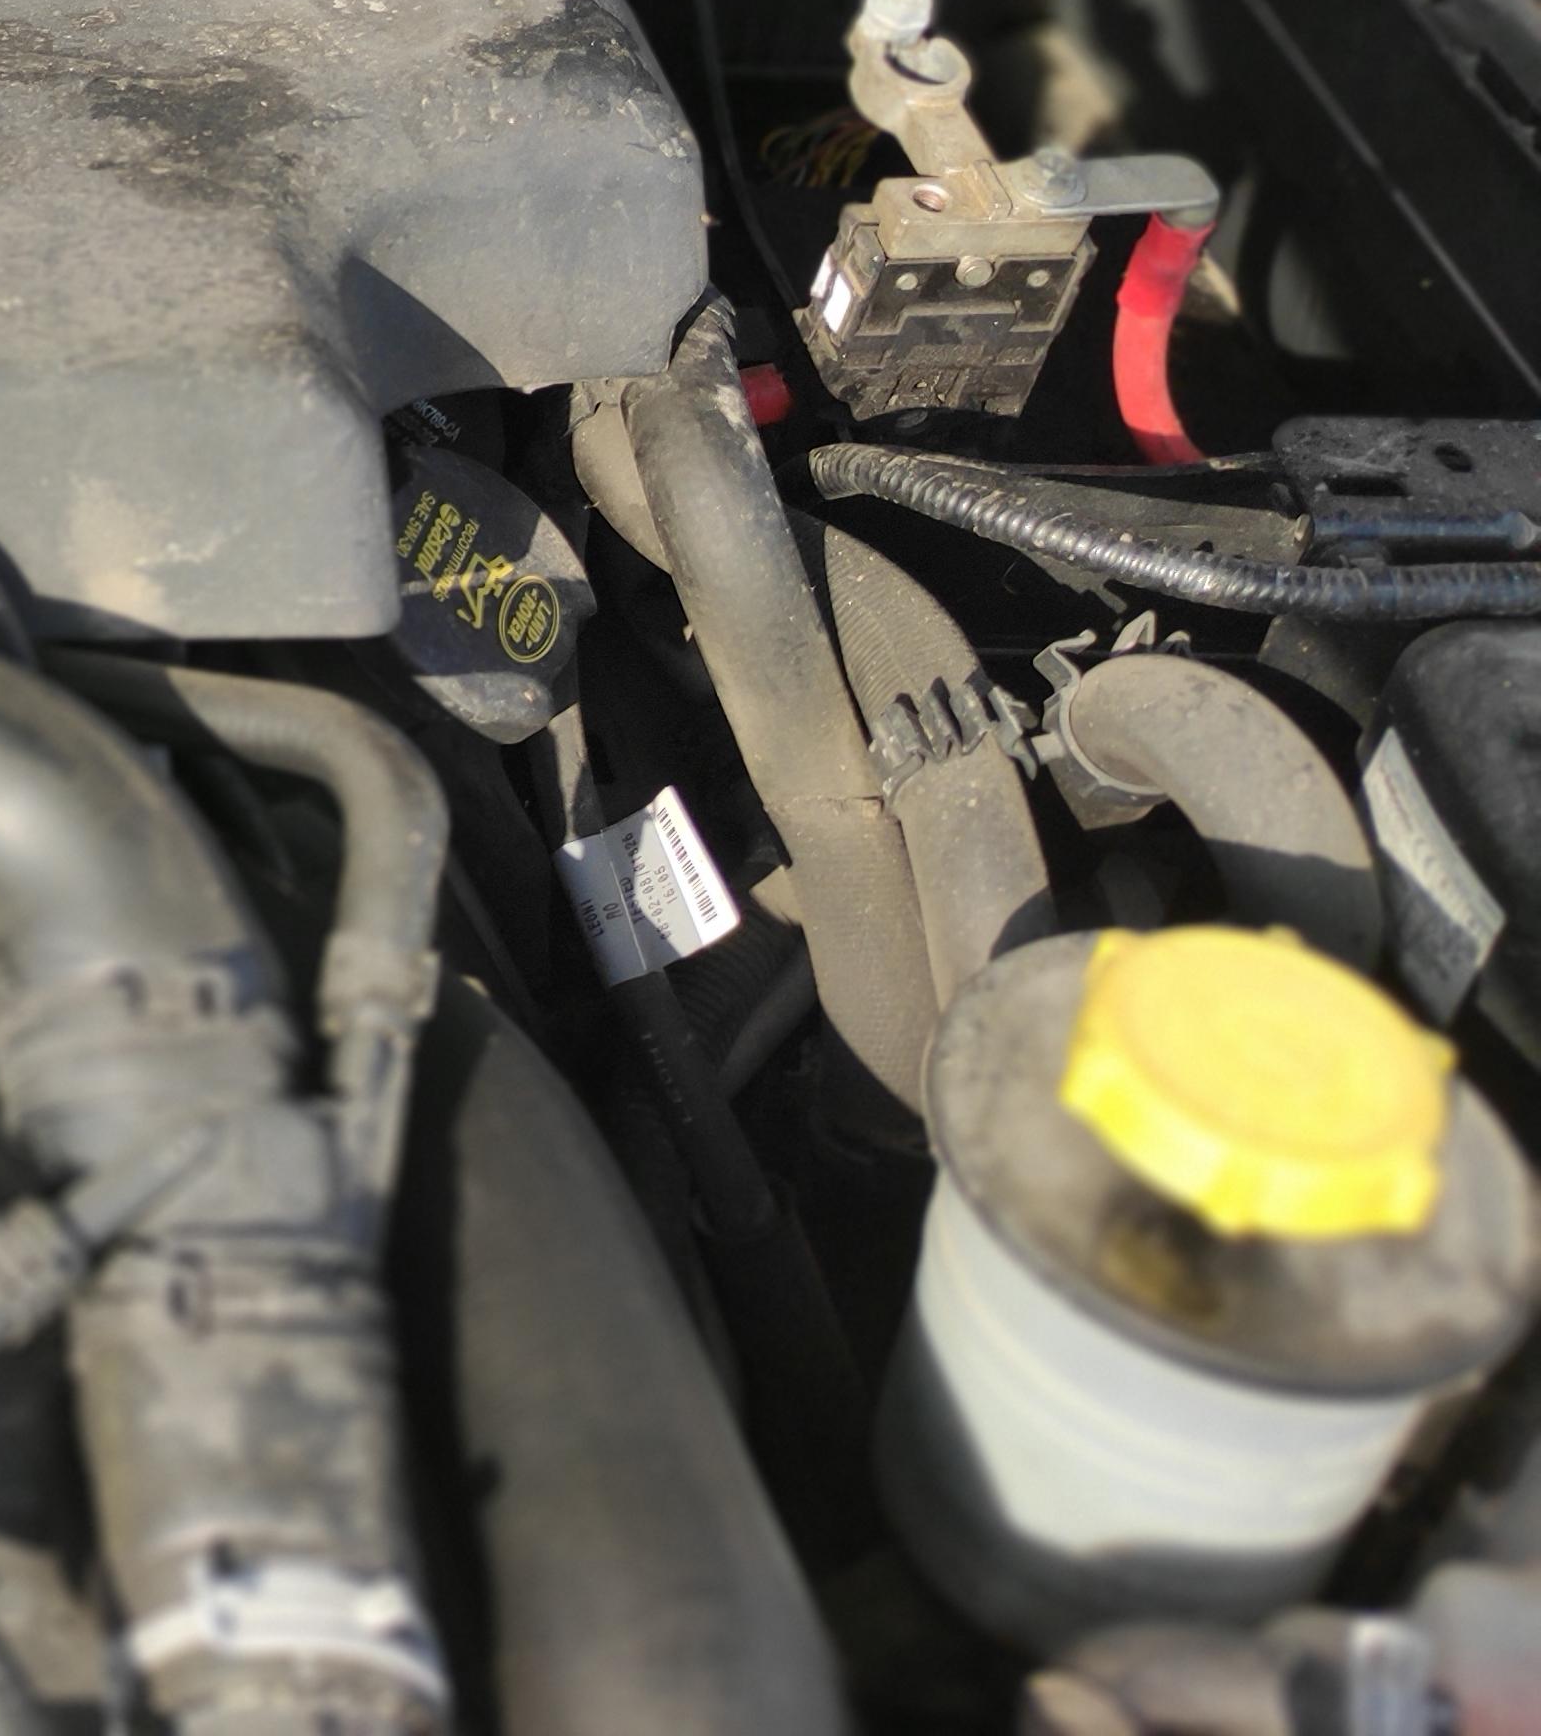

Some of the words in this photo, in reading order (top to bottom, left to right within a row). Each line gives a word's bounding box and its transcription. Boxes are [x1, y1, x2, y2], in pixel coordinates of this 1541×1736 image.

[414, 490, 437, 522] SAE
[414, 517, 453, 582] Castrol
[432, 517, 481, 603] recommends
[619, 876, 646, 925] TESTED
